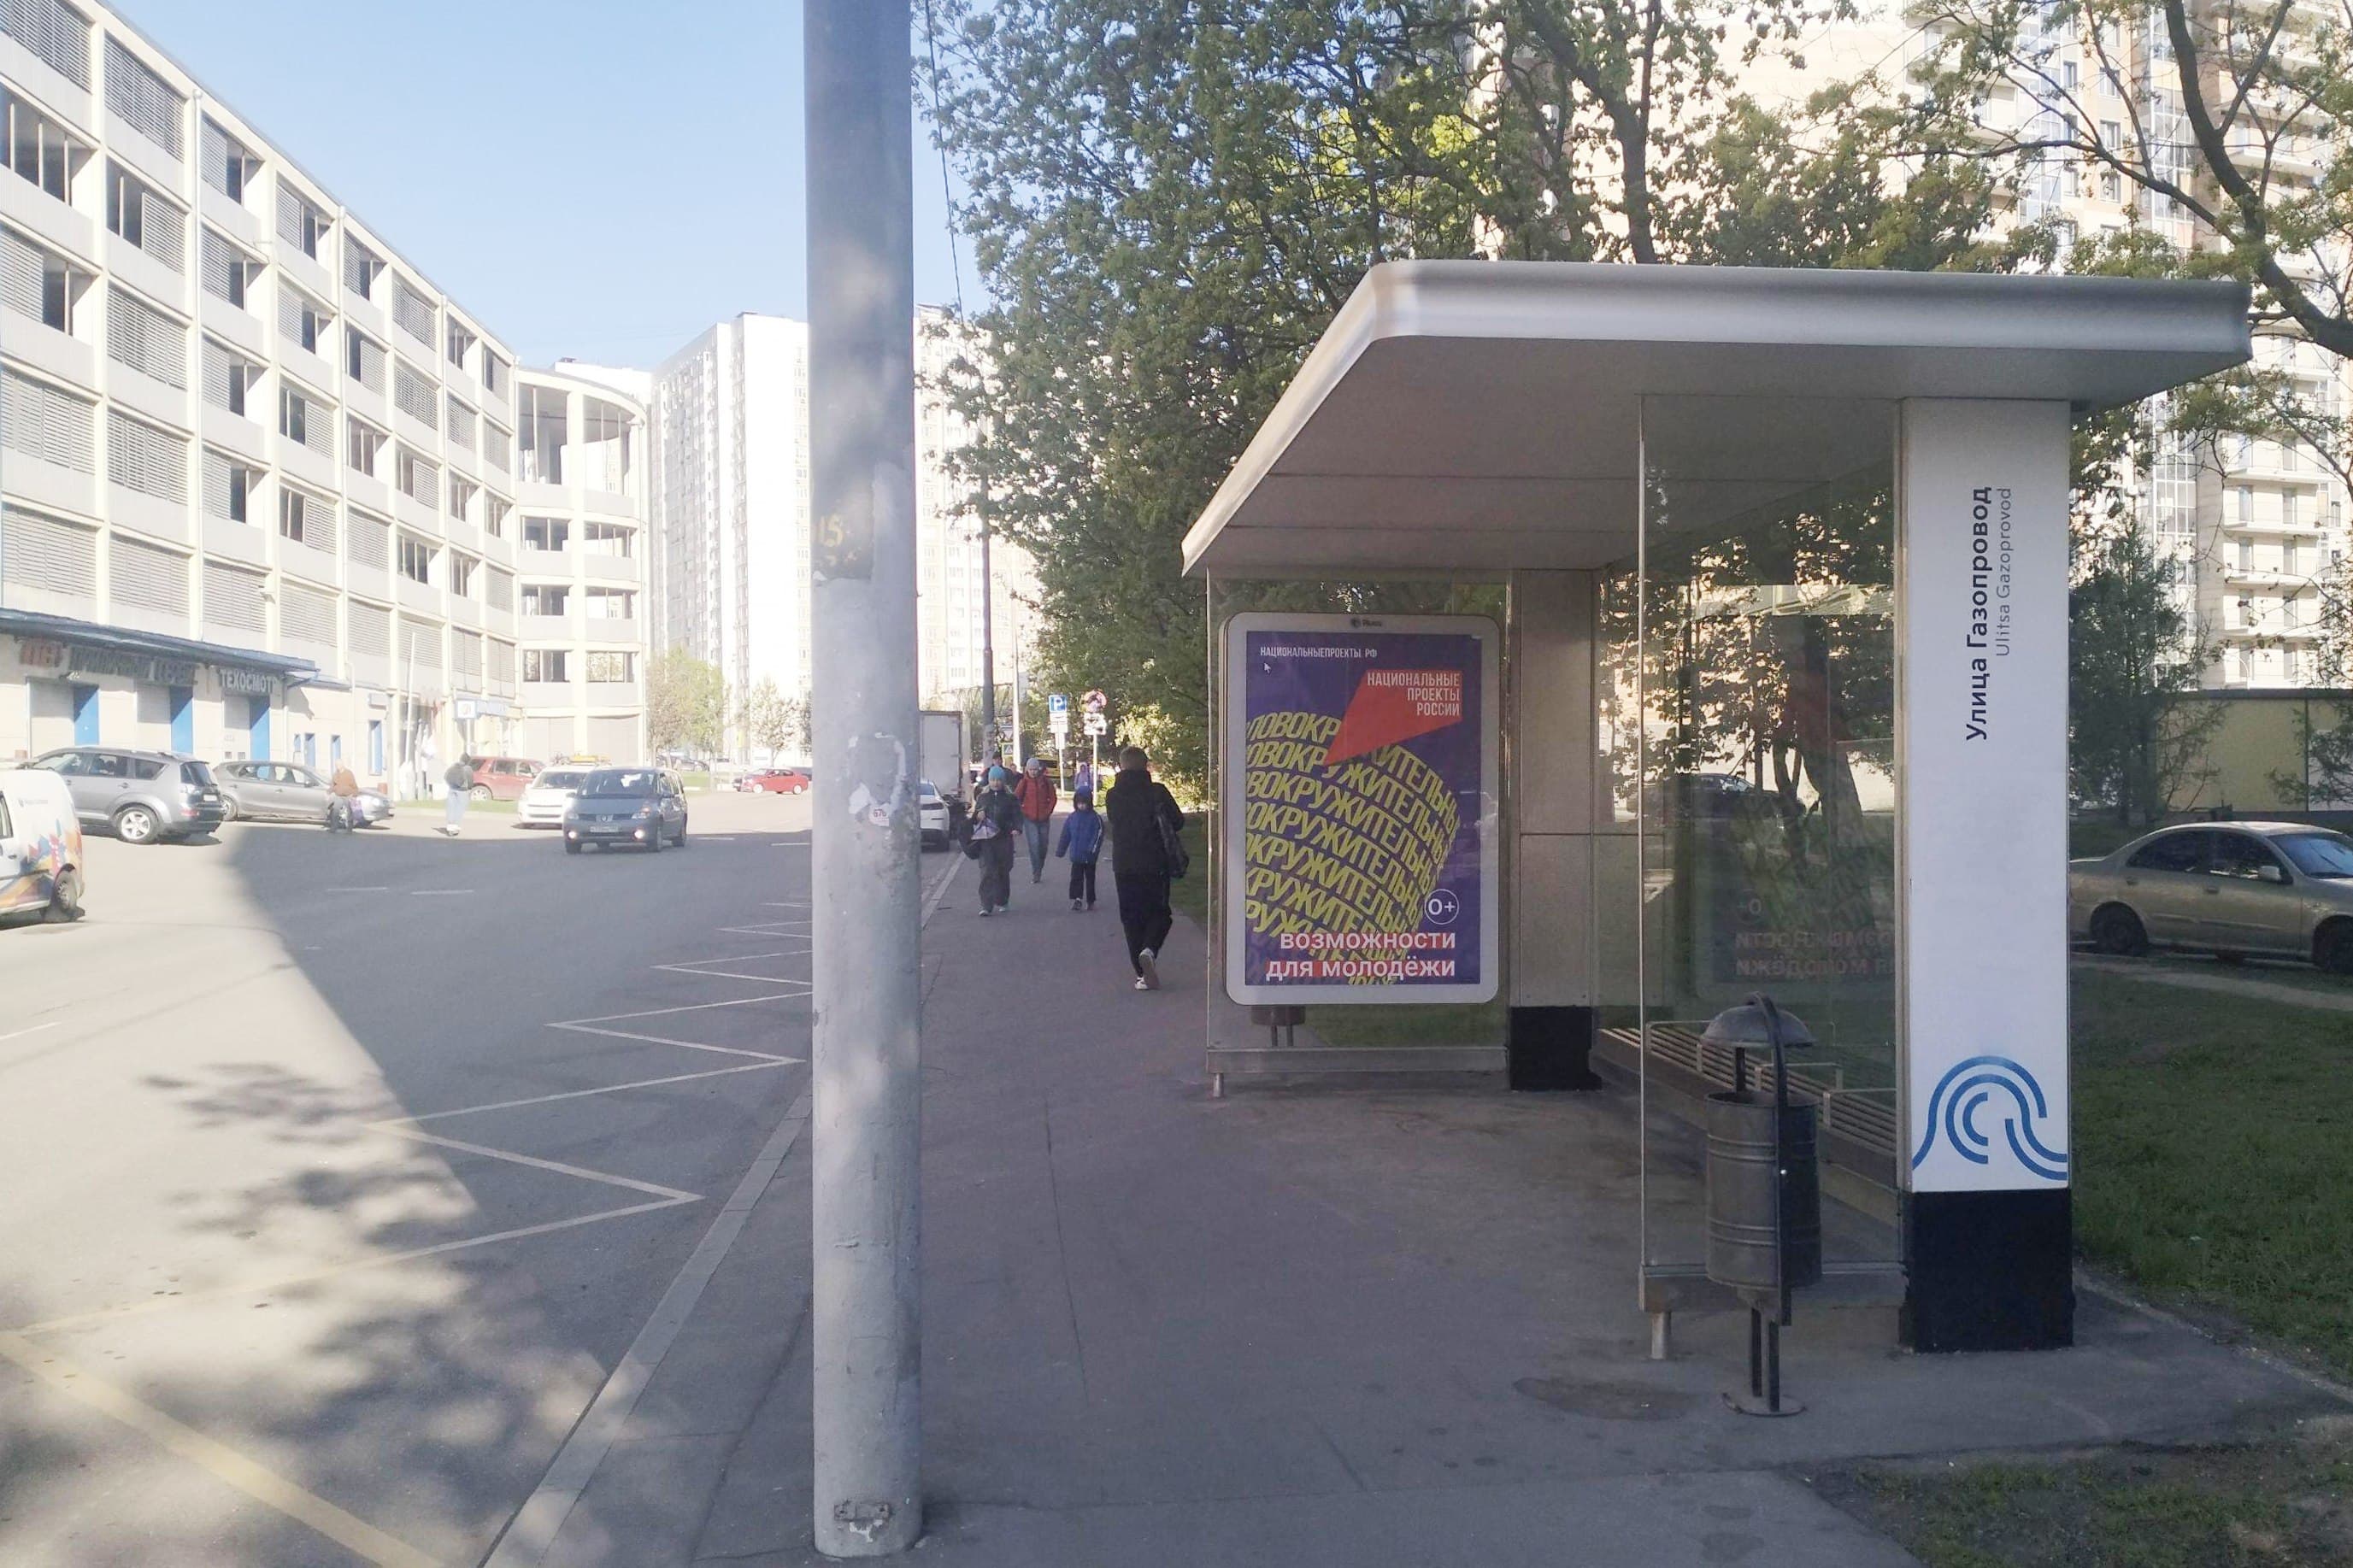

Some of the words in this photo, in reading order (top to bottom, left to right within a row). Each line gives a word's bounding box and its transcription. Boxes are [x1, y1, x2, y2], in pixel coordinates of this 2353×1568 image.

[1996, 488, 2014, 598] Gazoprovod
[1967, 486, 1992, 648] Газопровод
[1996, 604, 2010, 656] Ulitsa
[1368, 672, 1460, 686] НАЦИОНАЛЬНЫЕ
[1408, 688, 1460, 701] ПРОЕКТЫ
[1417, 703, 1460, 716] РОССИИ
[1967, 658, 1990, 740] Улица
[1428, 898, 1456, 915] 0+
